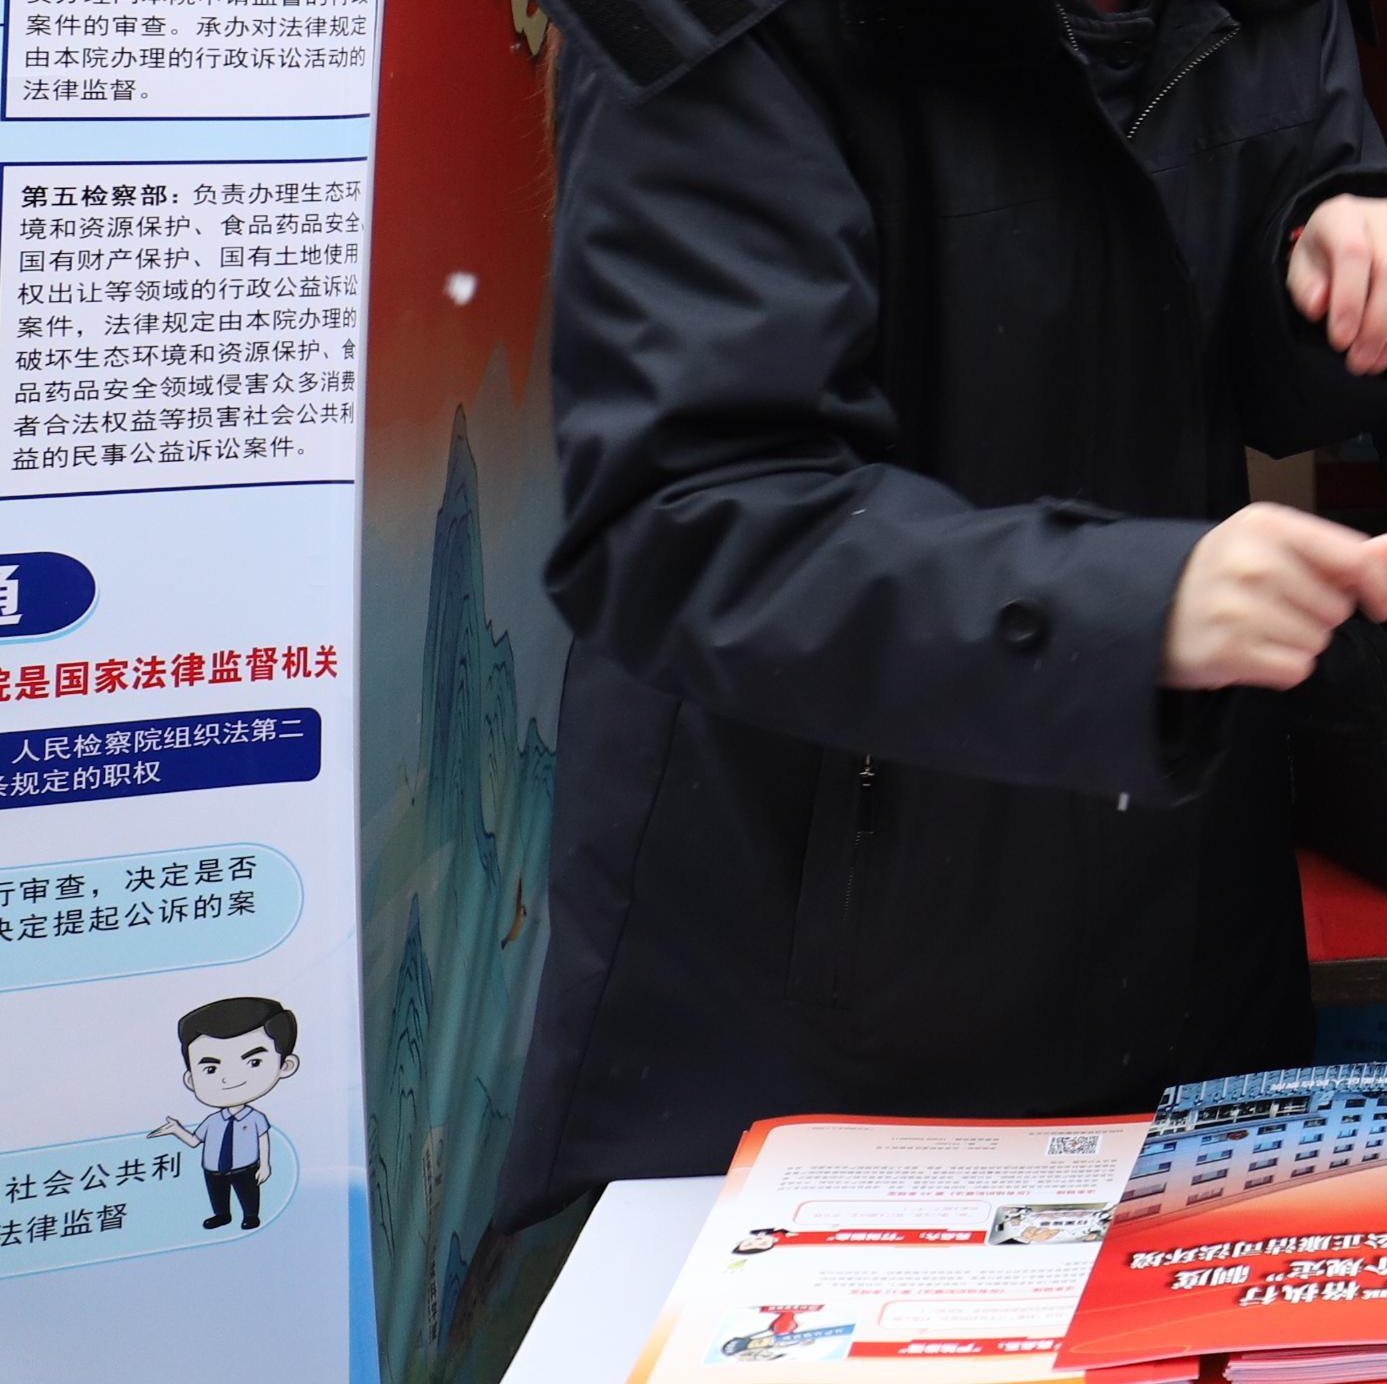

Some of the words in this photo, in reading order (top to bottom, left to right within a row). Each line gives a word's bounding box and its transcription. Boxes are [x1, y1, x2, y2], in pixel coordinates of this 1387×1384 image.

[26, 13, 367, 38] 案件的审查。承办对法律规定
[25, 46, 366, 70] 由本院办理的行政诉讼活动的
[23, 79, 150, 102] 法律监督。
[19, 243, 358, 273] 国有财产保护、国有土地使用
[17, 275, 358, 305] 权出让等领域的行政公益诉讼
[17, 306, 357, 338] 案件，法律规定由本院办理的
[16, 338, 356, 371] 破坏生态环境和资源保护、食
[15, 370, 355, 404] 品药品安全领域侵害众多消费
[13, 402, 354, 437] 者合法权益等损害社会公共利
[11, 436, 305, 471] 益的民事公益诉讼案件。
[6, 1151, 181, 1203] 社会公共利
